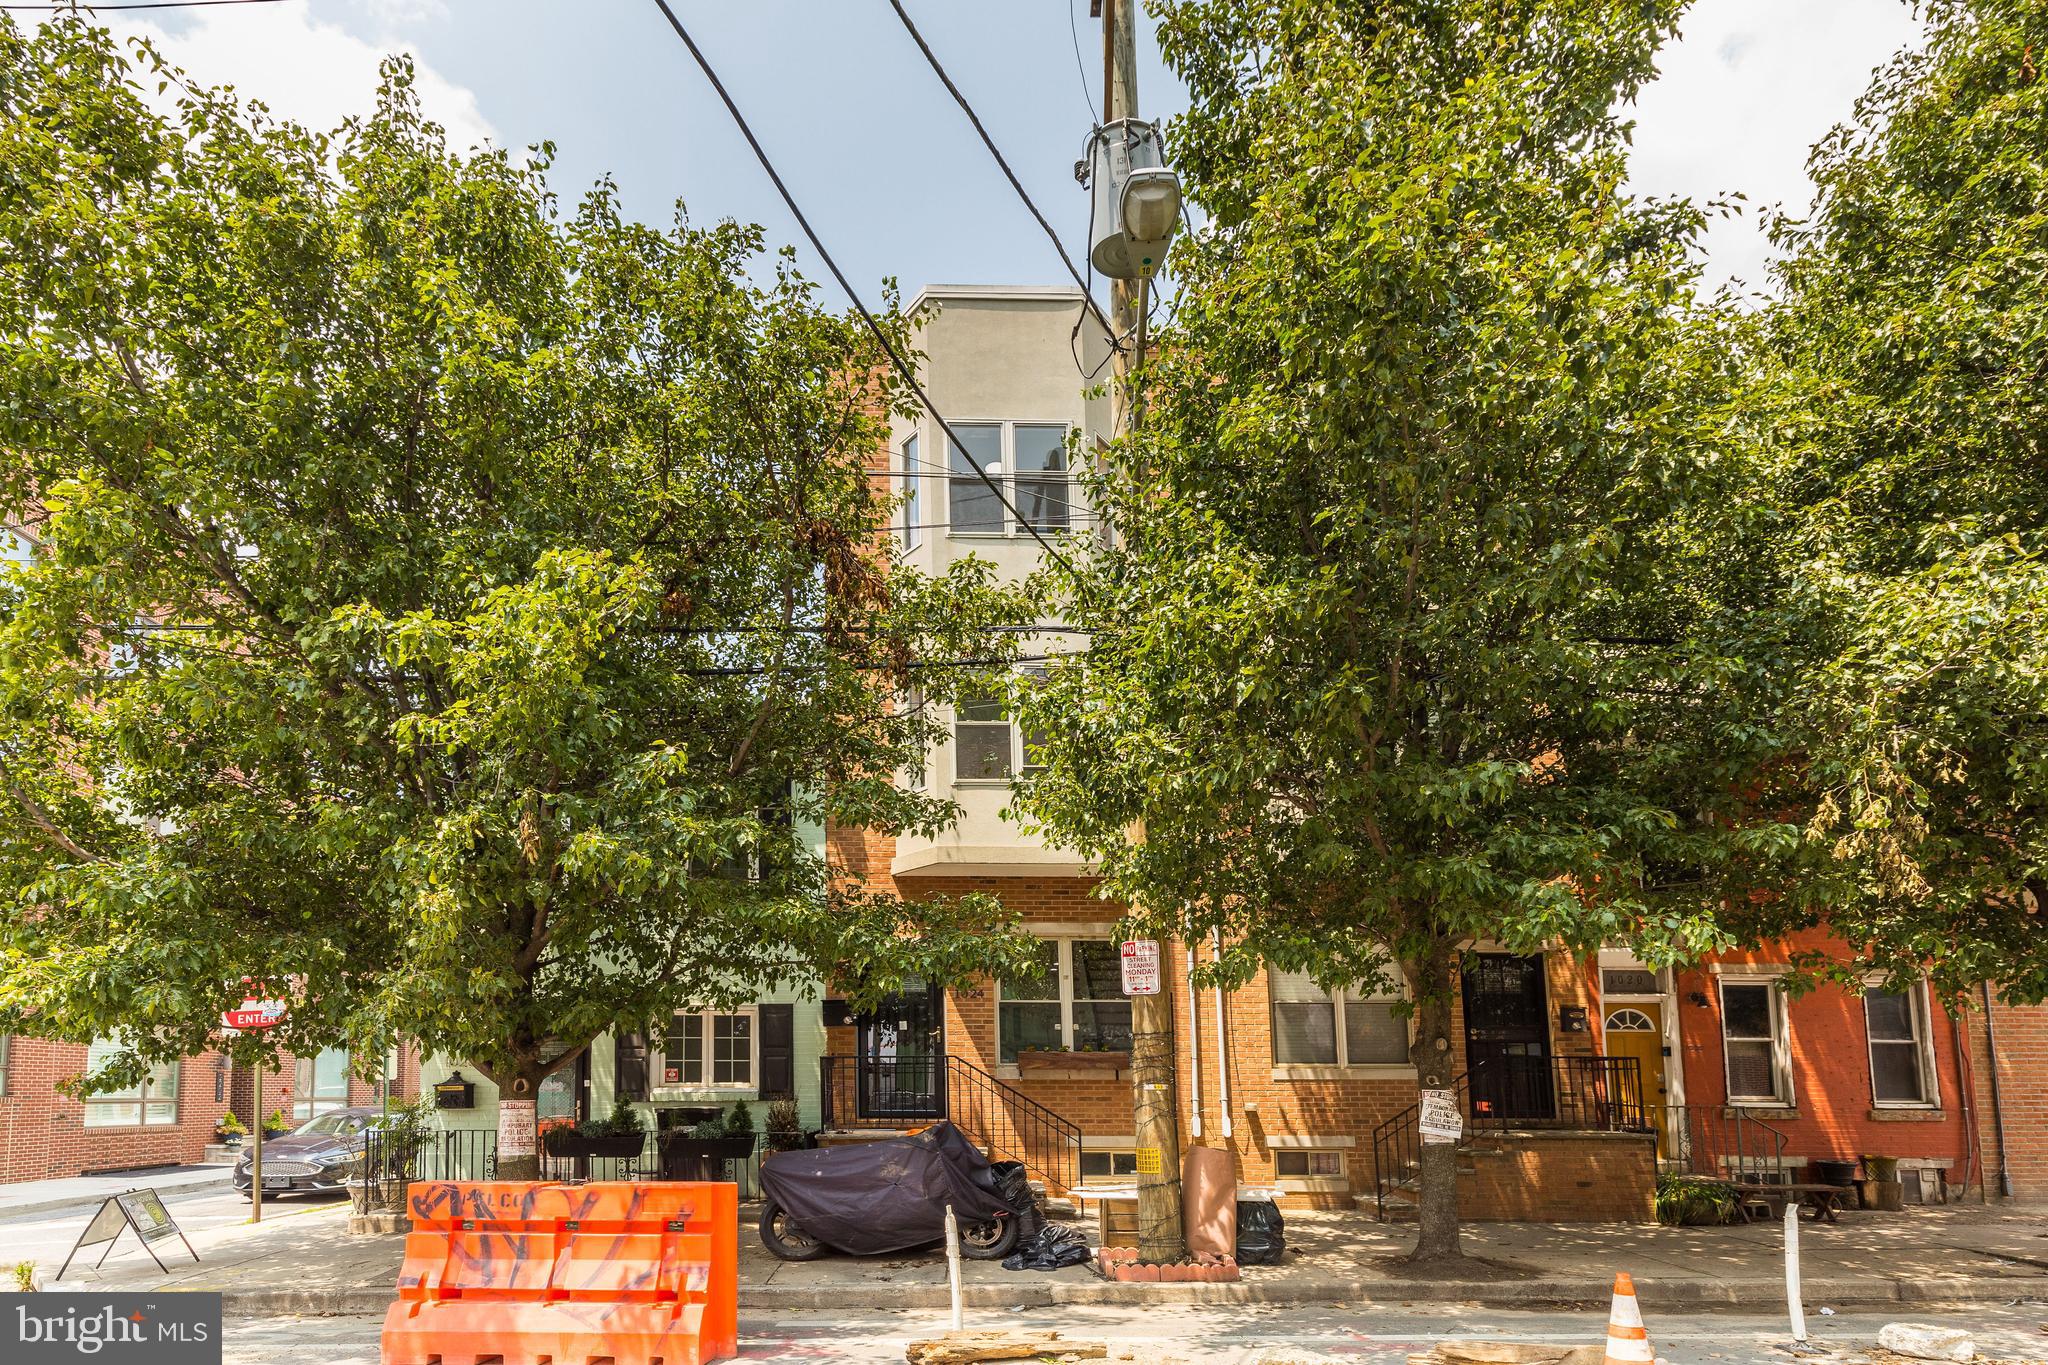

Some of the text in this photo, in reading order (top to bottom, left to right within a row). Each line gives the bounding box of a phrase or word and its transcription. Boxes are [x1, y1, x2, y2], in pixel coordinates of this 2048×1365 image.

[1142, 266, 1151, 275] 10
[1123, 944, 1135, 955] NO
[1125, 968, 1156, 976] MONDAY
[1610, 975, 1643, 985] 1020
[955, 989, 984, 999] 1024
[237, 1014, 276, 1024] ENTER
[1430, 1110, 1455, 1119] POLICE
[1425, 1116, 1459, 1125] REGULATION
